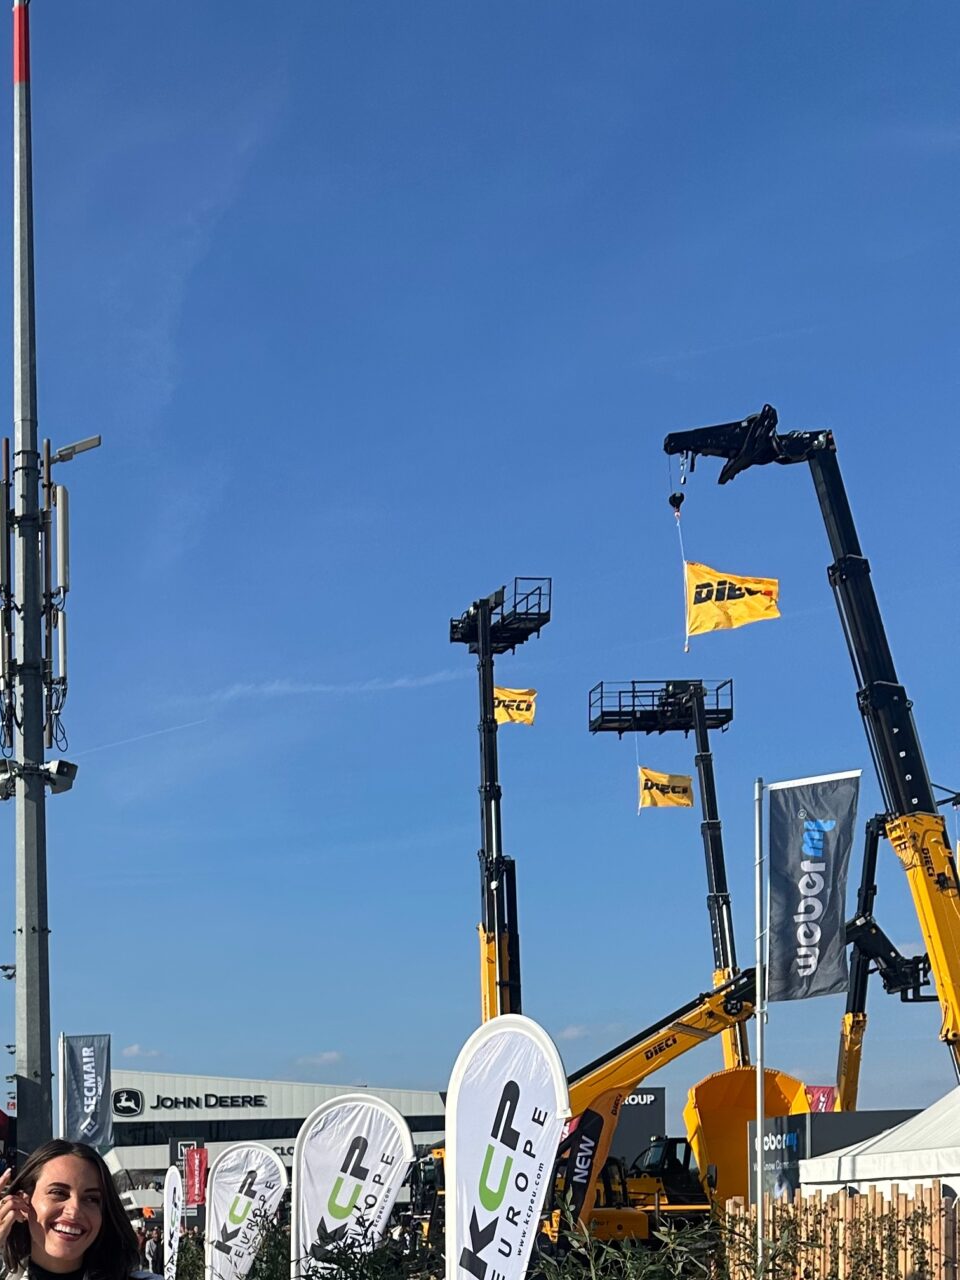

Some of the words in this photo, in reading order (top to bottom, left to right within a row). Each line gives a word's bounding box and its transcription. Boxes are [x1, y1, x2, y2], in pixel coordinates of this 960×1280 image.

[921, 847, 936, 877] DIECI
[644, 1035, 678, 1061] DIECI
[82, 1046, 96, 1114] SECMAIR
[150, 1095, 202, 1110] JOHN
[204, 1093, 267, 1109] DEERE
[573, 1136, 596, 1184] NEW
[214, 1170, 257, 1256] KCP
[517, 1162, 544, 1256] www.kcpeu.com
